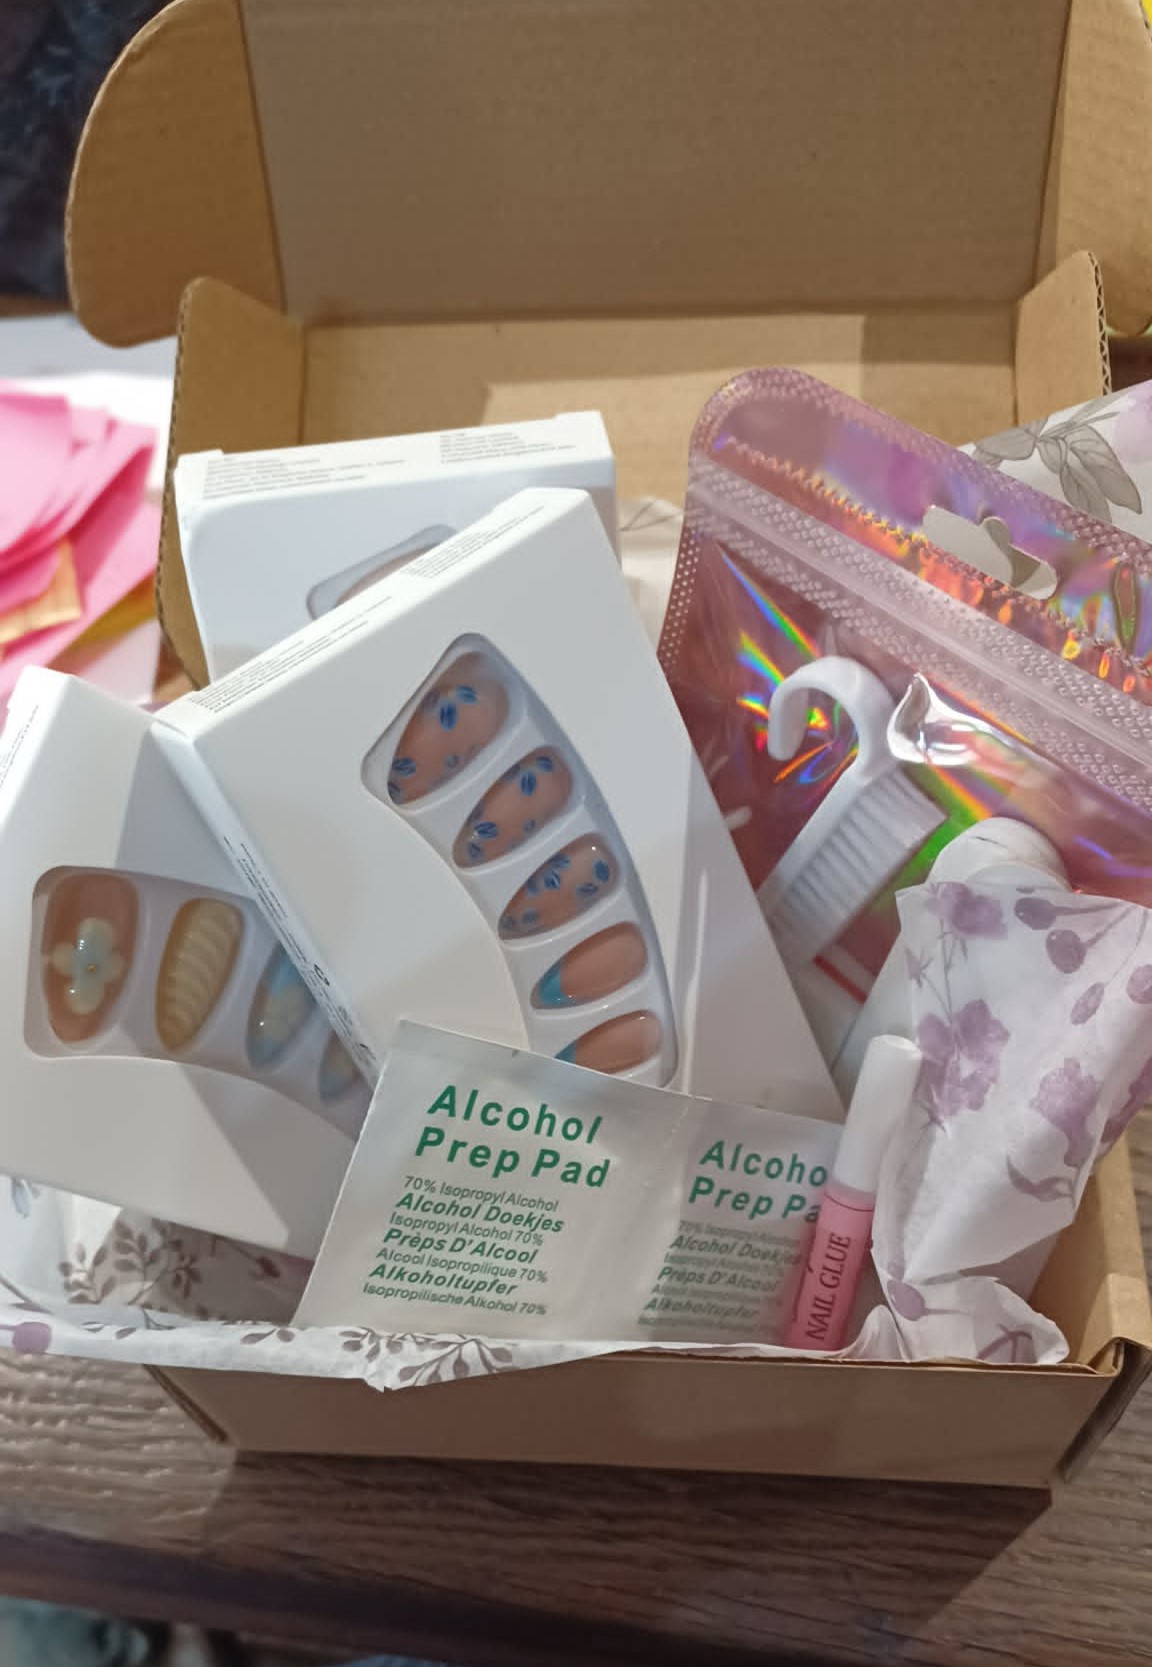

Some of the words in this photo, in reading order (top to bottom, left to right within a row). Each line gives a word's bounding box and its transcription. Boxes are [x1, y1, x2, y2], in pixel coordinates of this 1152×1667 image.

[426, 1085, 603, 1144] Alcohol
[415, 1126, 520, 1179] Prep
[531, 1148, 610, 1188] Pad
[699, 1140, 828, 1187] Alcoho
[395, 1192, 482, 1219] Alcohol
[484, 1205, 565, 1233] Doekjes
[404, 1175, 436, 1193] 70%
[440, 1182, 505, 1204] Isopropyl
[503, 1193, 559, 1212] Alcohol
[688, 1176, 773, 1220] Prep
[782, 1193, 822, 1222] Pa
[389, 1211, 459, 1235] Isopropyl
[459, 1222, 513, 1242] Alcohol
[514, 1230, 544, 1246] 70%
[376, 1247, 426, 1265] Alcool
[519, 1268, 548, 1283] 70%
[448, 1237, 539, 1264] D'Alcool
[819, 1232, 852, 1289] GLUE
[369, 1263, 519, 1295] Alkoholtupfer
[464, 1295, 518, 1313] Alkohol
[519, 1302, 548, 1316] 70%
[805, 1292, 837, 1342] NAIL
